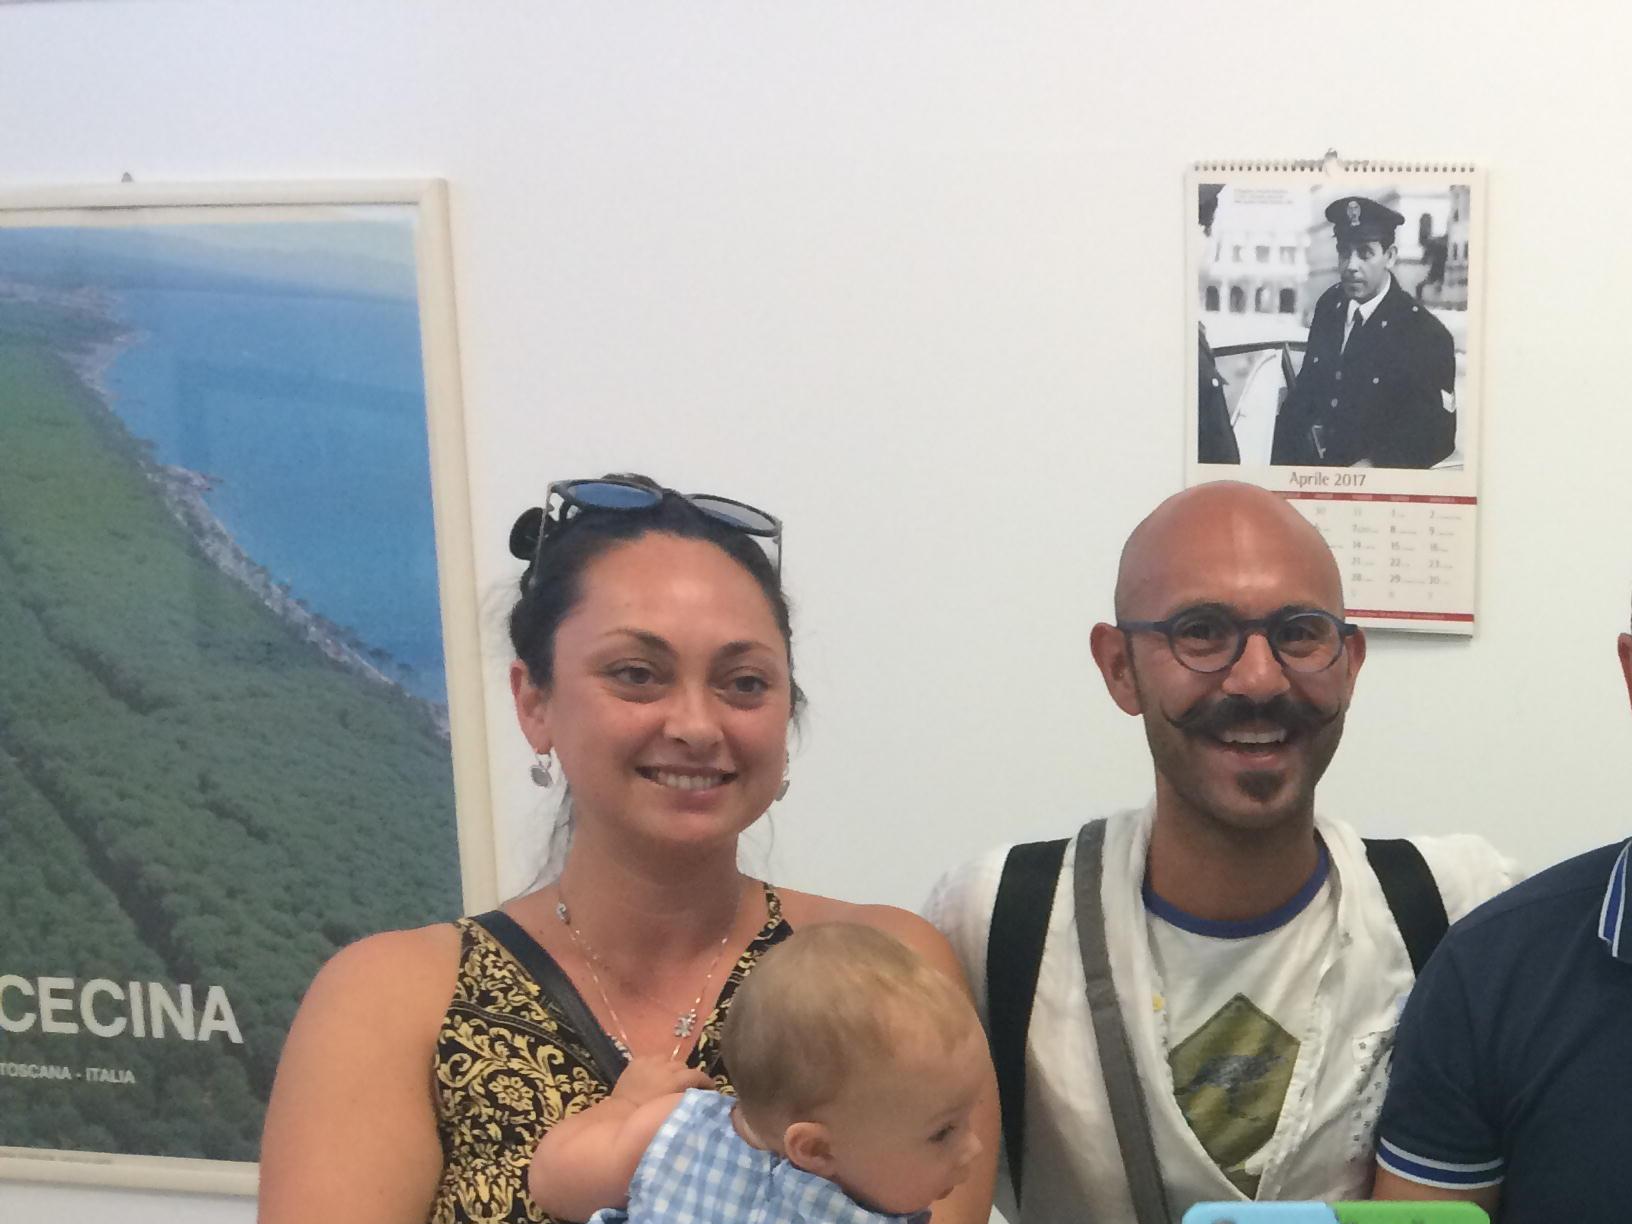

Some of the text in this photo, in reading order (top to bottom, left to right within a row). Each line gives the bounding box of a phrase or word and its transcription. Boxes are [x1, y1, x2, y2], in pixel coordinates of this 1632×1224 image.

[1289, 471, 1366, 487] Aprile 2017
[0, 974, 244, 1044] CECINA
[85, 1067, 136, 1083] ITALIA
